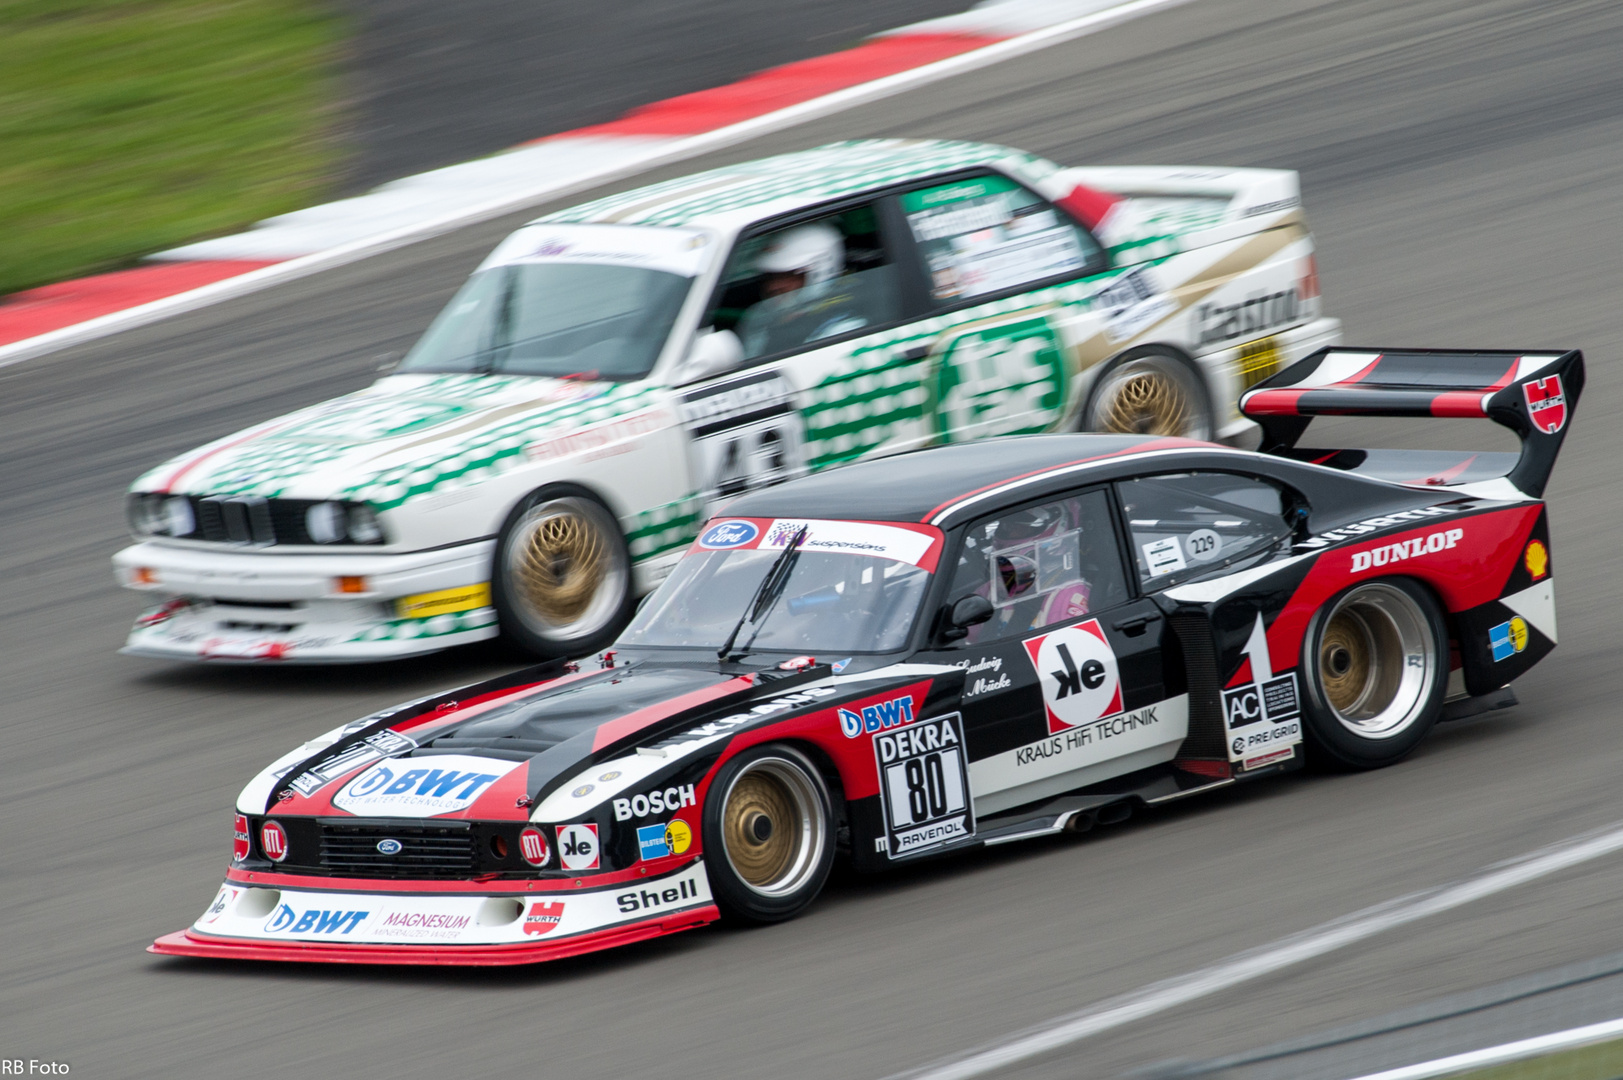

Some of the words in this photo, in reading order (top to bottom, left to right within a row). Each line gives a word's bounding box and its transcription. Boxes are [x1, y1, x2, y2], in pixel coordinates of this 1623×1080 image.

[708, 525, 747, 544] Ford
[1191, 535, 1215, 554] 229
[1350, 527, 1464, 573] DUNLOP
[688, 687, 837, 735] KRAUS
[860, 694, 915, 733] BWT
[1229, 692, 1260, 723] AC
[878, 719, 959, 764] DEKRA
[1016, 737, 1063, 767] KRAUS
[1066, 728, 1093, 751] HiFi
[1095, 706, 1160, 741] TECHNIK
[1248, 723, 1299, 747] PRE/GRID
[386, 769, 501, 800] BWT
[905, 752, 948, 824] 80
[337, 797, 363, 807] BEST
[364, 796, 400, 805] WATER
[400, 796, 468, 809] TECHNOLOGY
[612, 783, 696, 822] BOSCH
[263, 828, 283, 854] RTL
[522, 835, 545, 859] RTL
[901, 823, 961, 847] RAVENOL
[616, 878, 698, 913] Shell
[291, 910, 370, 935] BWT
[383, 912, 471, 929] MAGNESIUM
